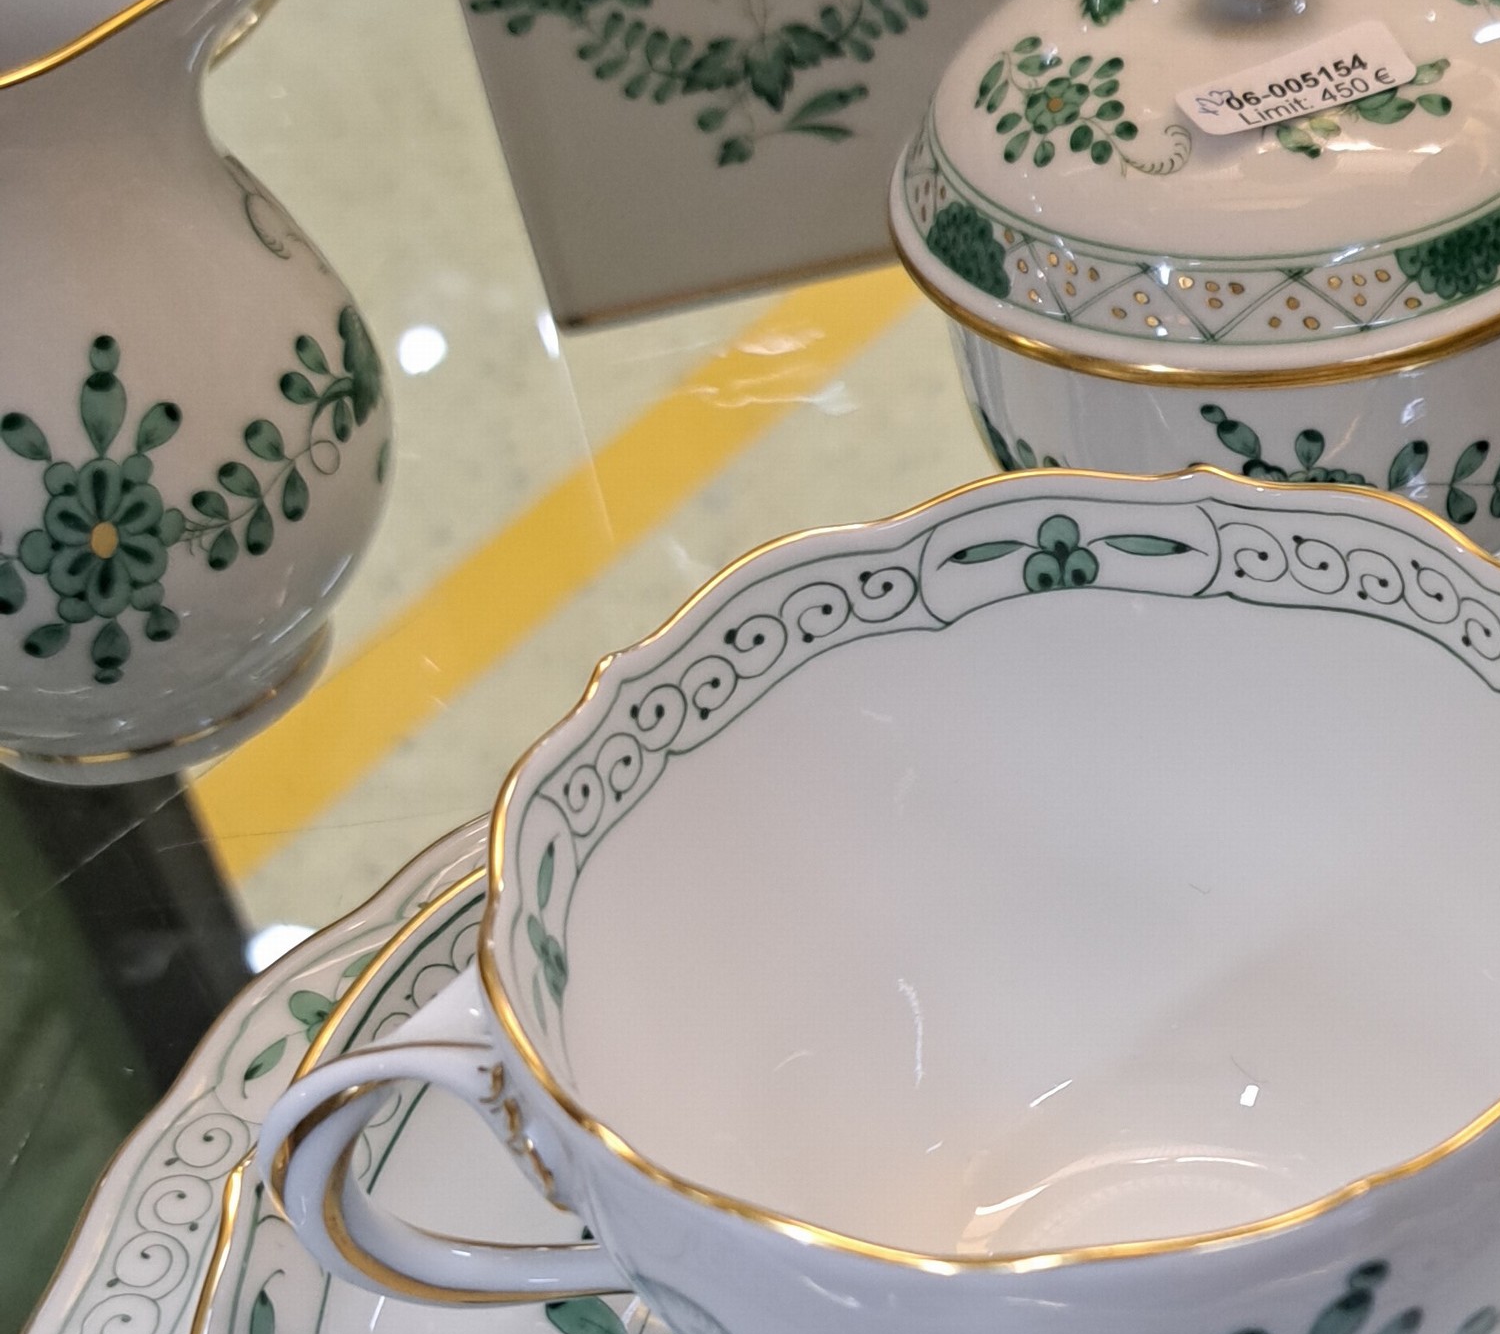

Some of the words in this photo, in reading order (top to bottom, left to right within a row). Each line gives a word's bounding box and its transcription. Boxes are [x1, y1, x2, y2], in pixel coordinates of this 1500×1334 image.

[1225, 54, 1368, 110] 06-005154
[1238, 98, 1314, 126] Limit:
[1320, 77, 1370, 103] 450
[1375, 68, 1396, 85] €
